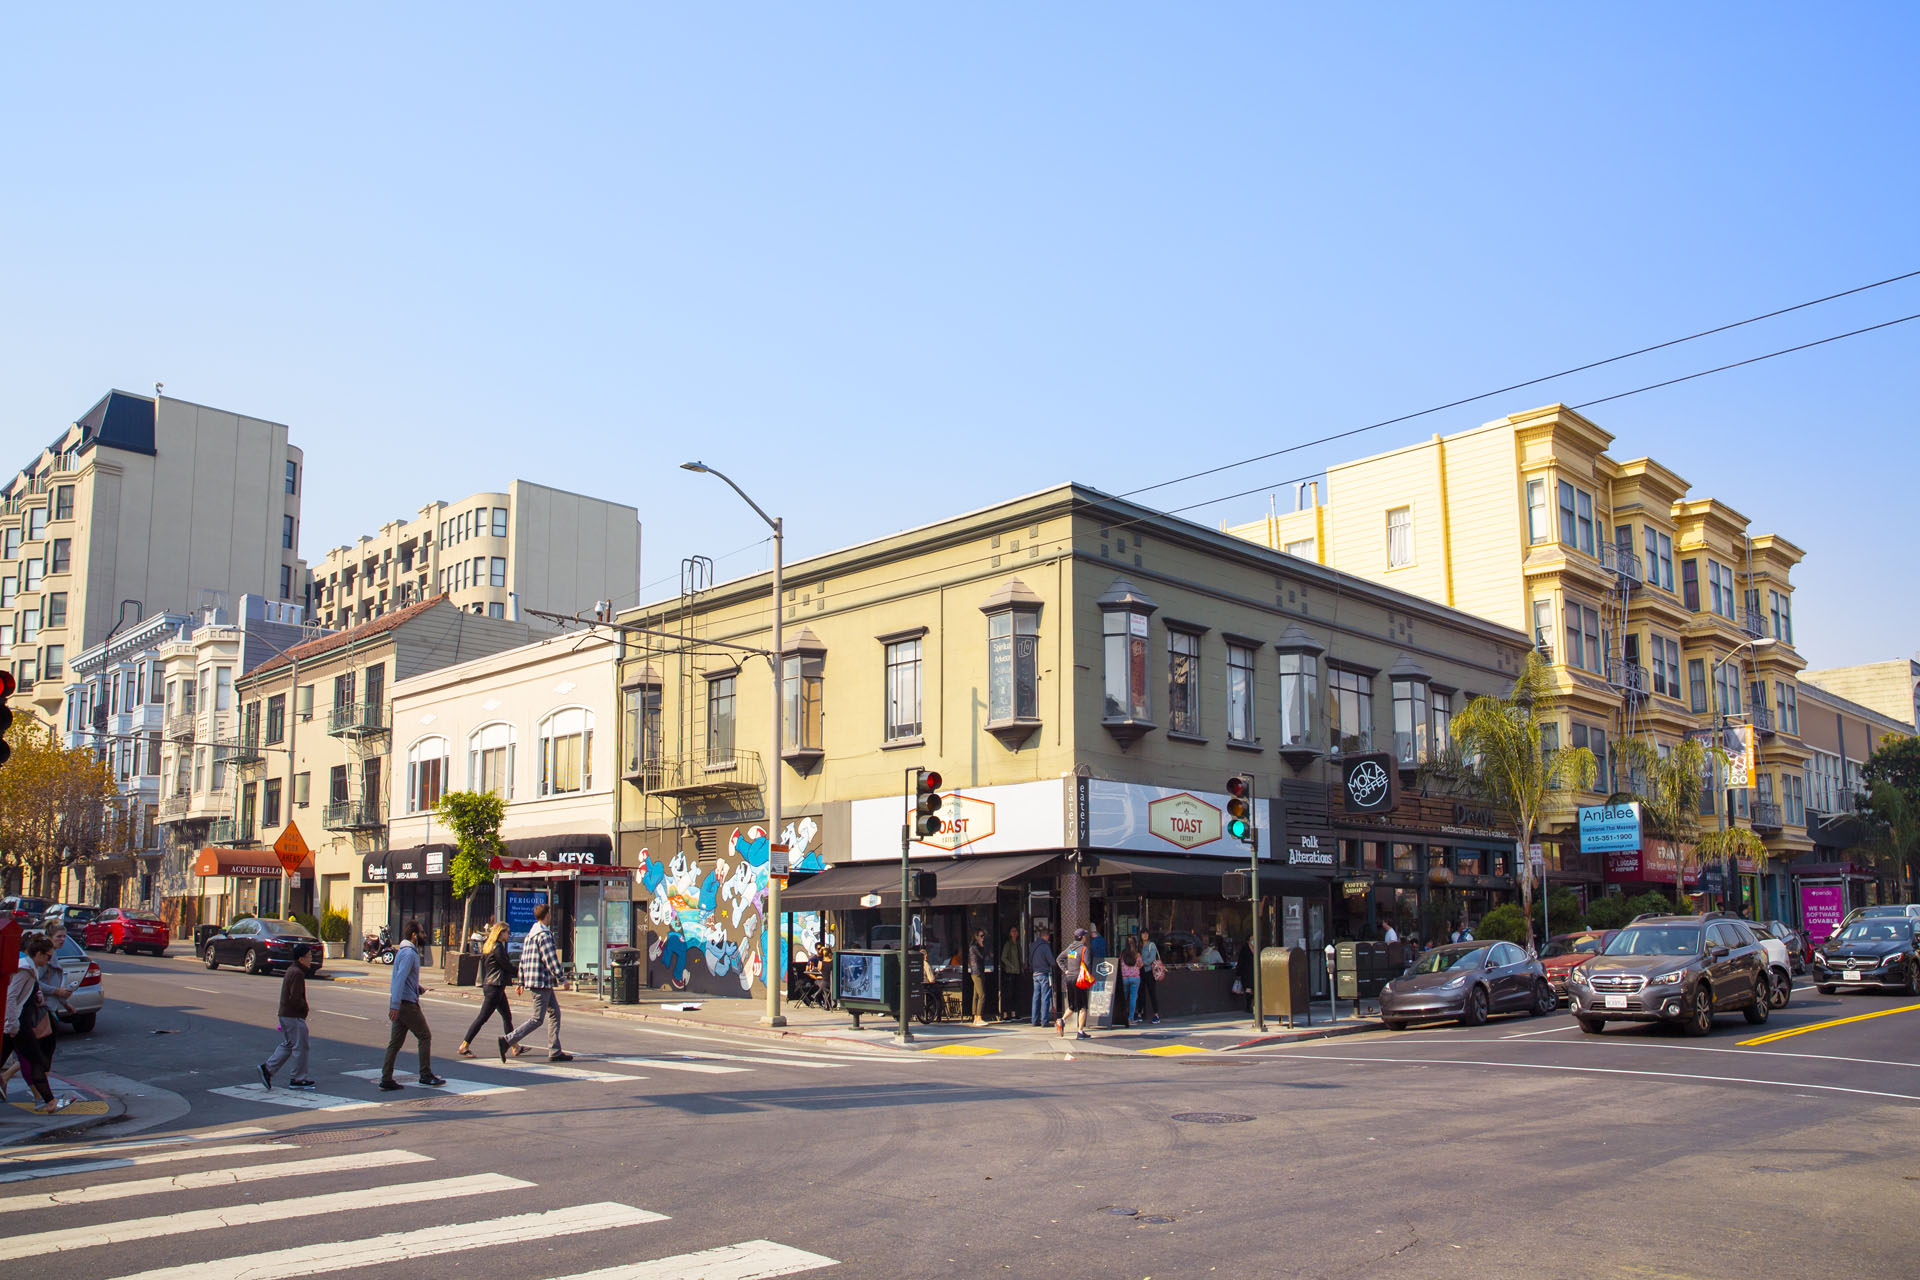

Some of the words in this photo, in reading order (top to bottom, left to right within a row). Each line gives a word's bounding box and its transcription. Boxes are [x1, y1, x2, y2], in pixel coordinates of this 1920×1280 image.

[1348, 763, 1386, 792] MOKA
[1353, 774, 1389, 802] COFFEE
[1583, 806, 1634, 823] Anjalee
[934, 818, 969, 834] OAST
[1170, 816, 1203, 834] TOAST
[1301, 835, 1319, 849] Polk
[1587, 833, 1633, 842] 415-351-1900
[282, 853, 300, 863] AHEAD
[558, 852, 595, 865] KEYS
[1288, 848, 1333, 865] Alterations
[230, 865, 282, 874] ACQUERELLO
[509, 897, 545, 905] PERIGOLD
